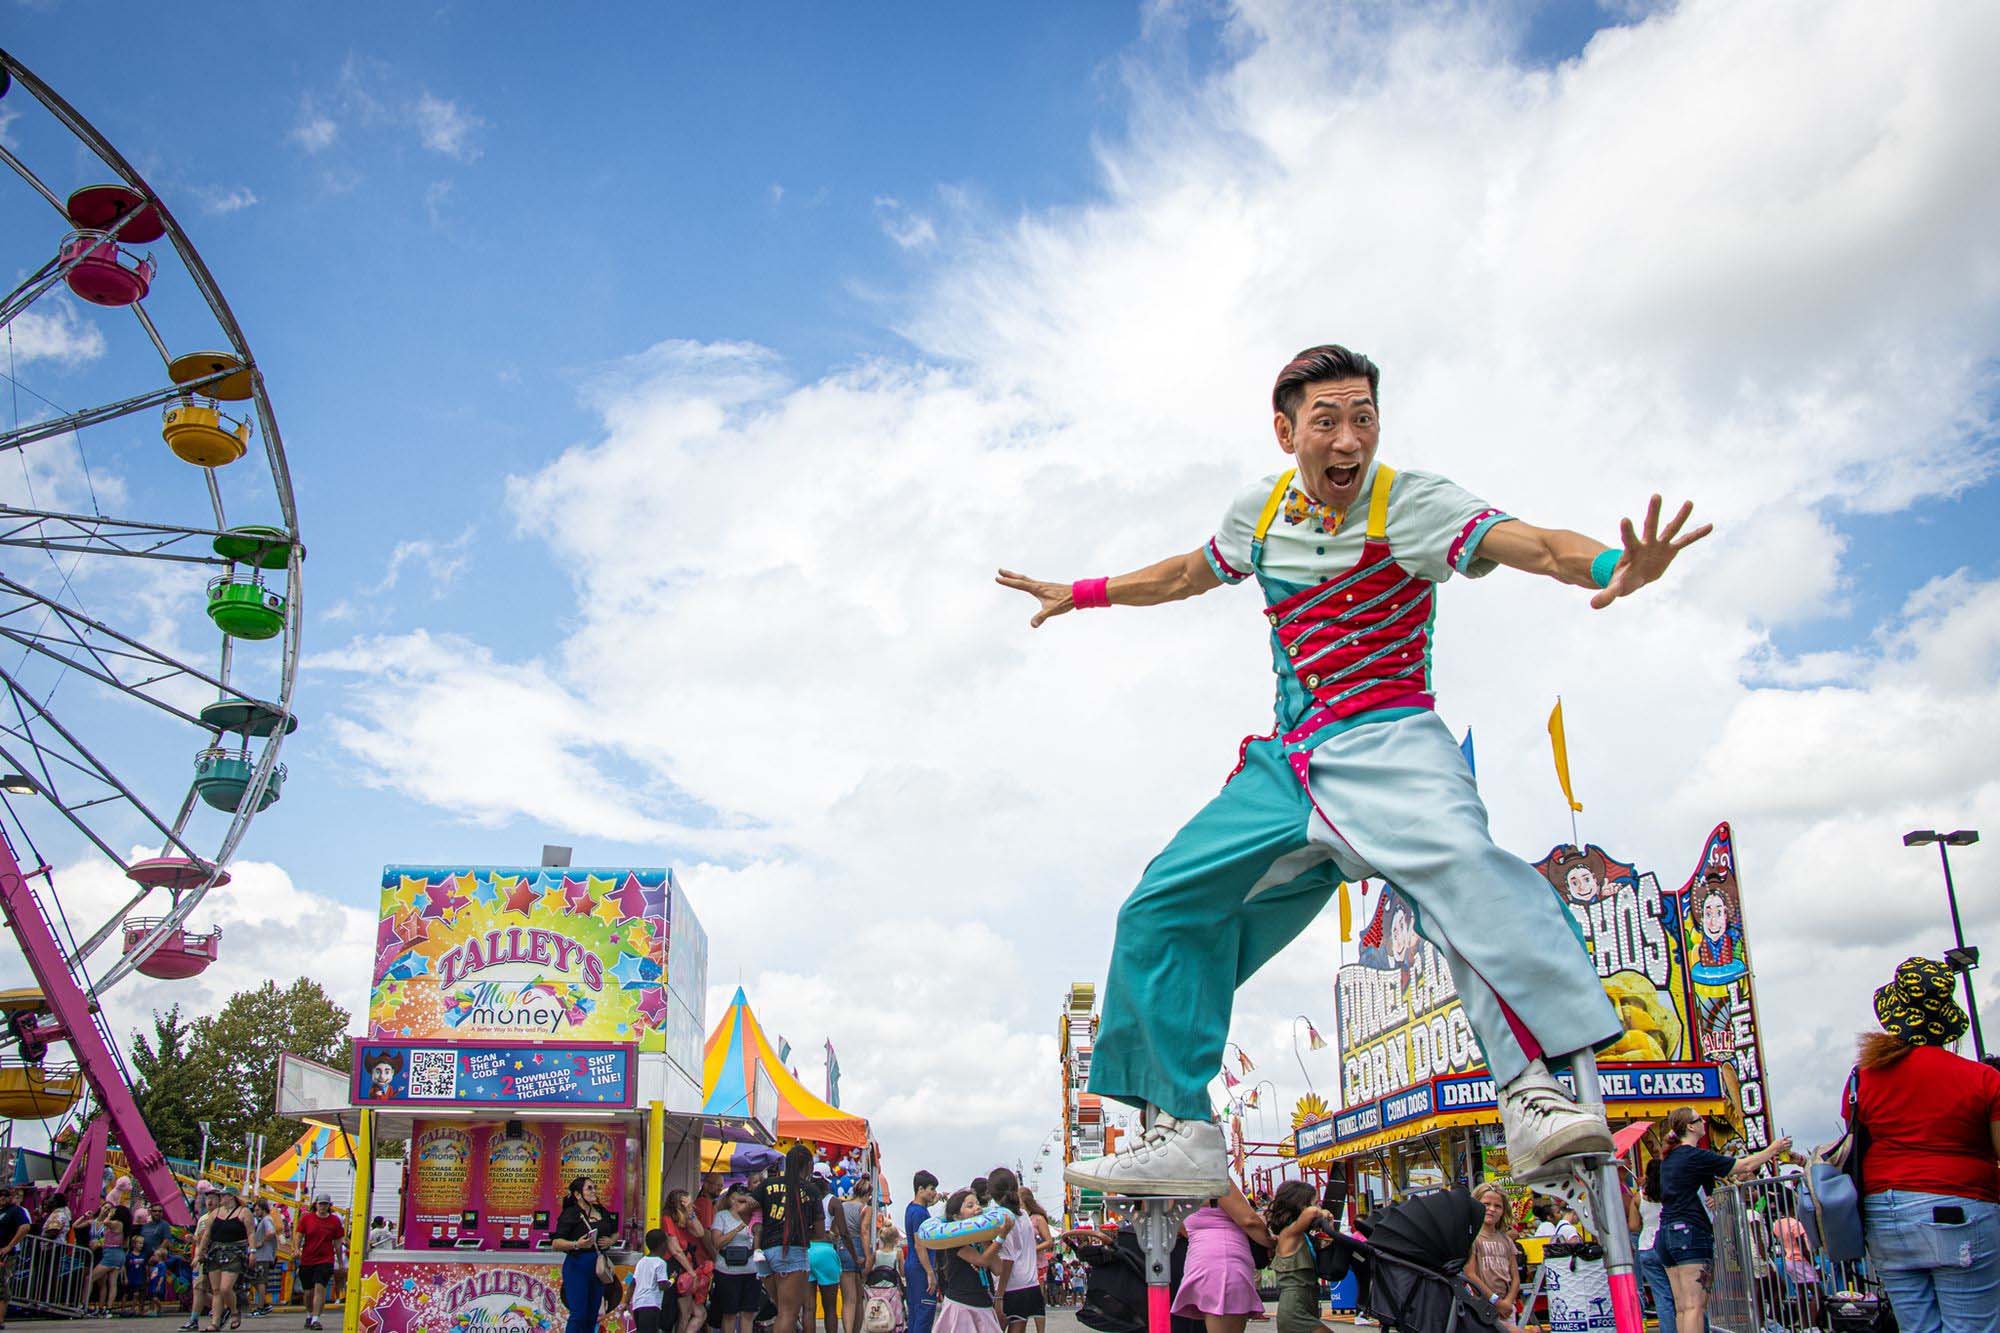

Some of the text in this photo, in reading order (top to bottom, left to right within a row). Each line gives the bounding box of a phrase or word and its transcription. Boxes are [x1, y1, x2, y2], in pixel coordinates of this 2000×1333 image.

[438, 927, 604, 991] TALLEY'S
[473, 981, 542, 1011] Magic
[1339, 965, 1410, 1050] FUNNEL
[473, 1008, 564, 1034] money
[460, 1055, 470, 1073] 1
[470, 1053, 497, 1064] SCAN
[471, 1059, 506, 1072] THE QR
[572, 1055, 589, 1076] 3
[588, 1054, 616, 1067] SKIP
[1345, 1030, 1411, 1105] CORN
[472, 1068, 498, 1079] CODE
[515, 1068, 571, 1085] DOWNLOAD
[589, 1064, 613, 1076] THE
[591, 1072, 621, 1086] LINE!
[501, 1075, 516, 1095] 2
[516, 1076, 570, 1092] THE TALLEY
[516, 1082, 577, 1100] TICKETS APP
[1639, 1073, 1705, 1094] CAKES
[1387, 1090, 1428, 1122] CORN DOGS
[1358, 1108, 1378, 1130] CAKES
[431, 1153, 458, 1162] money
[501, 1154, 530, 1163] money
[572, 1155, 600, 1165] money
[447, 1268, 558, 1315] TALLEY'S
